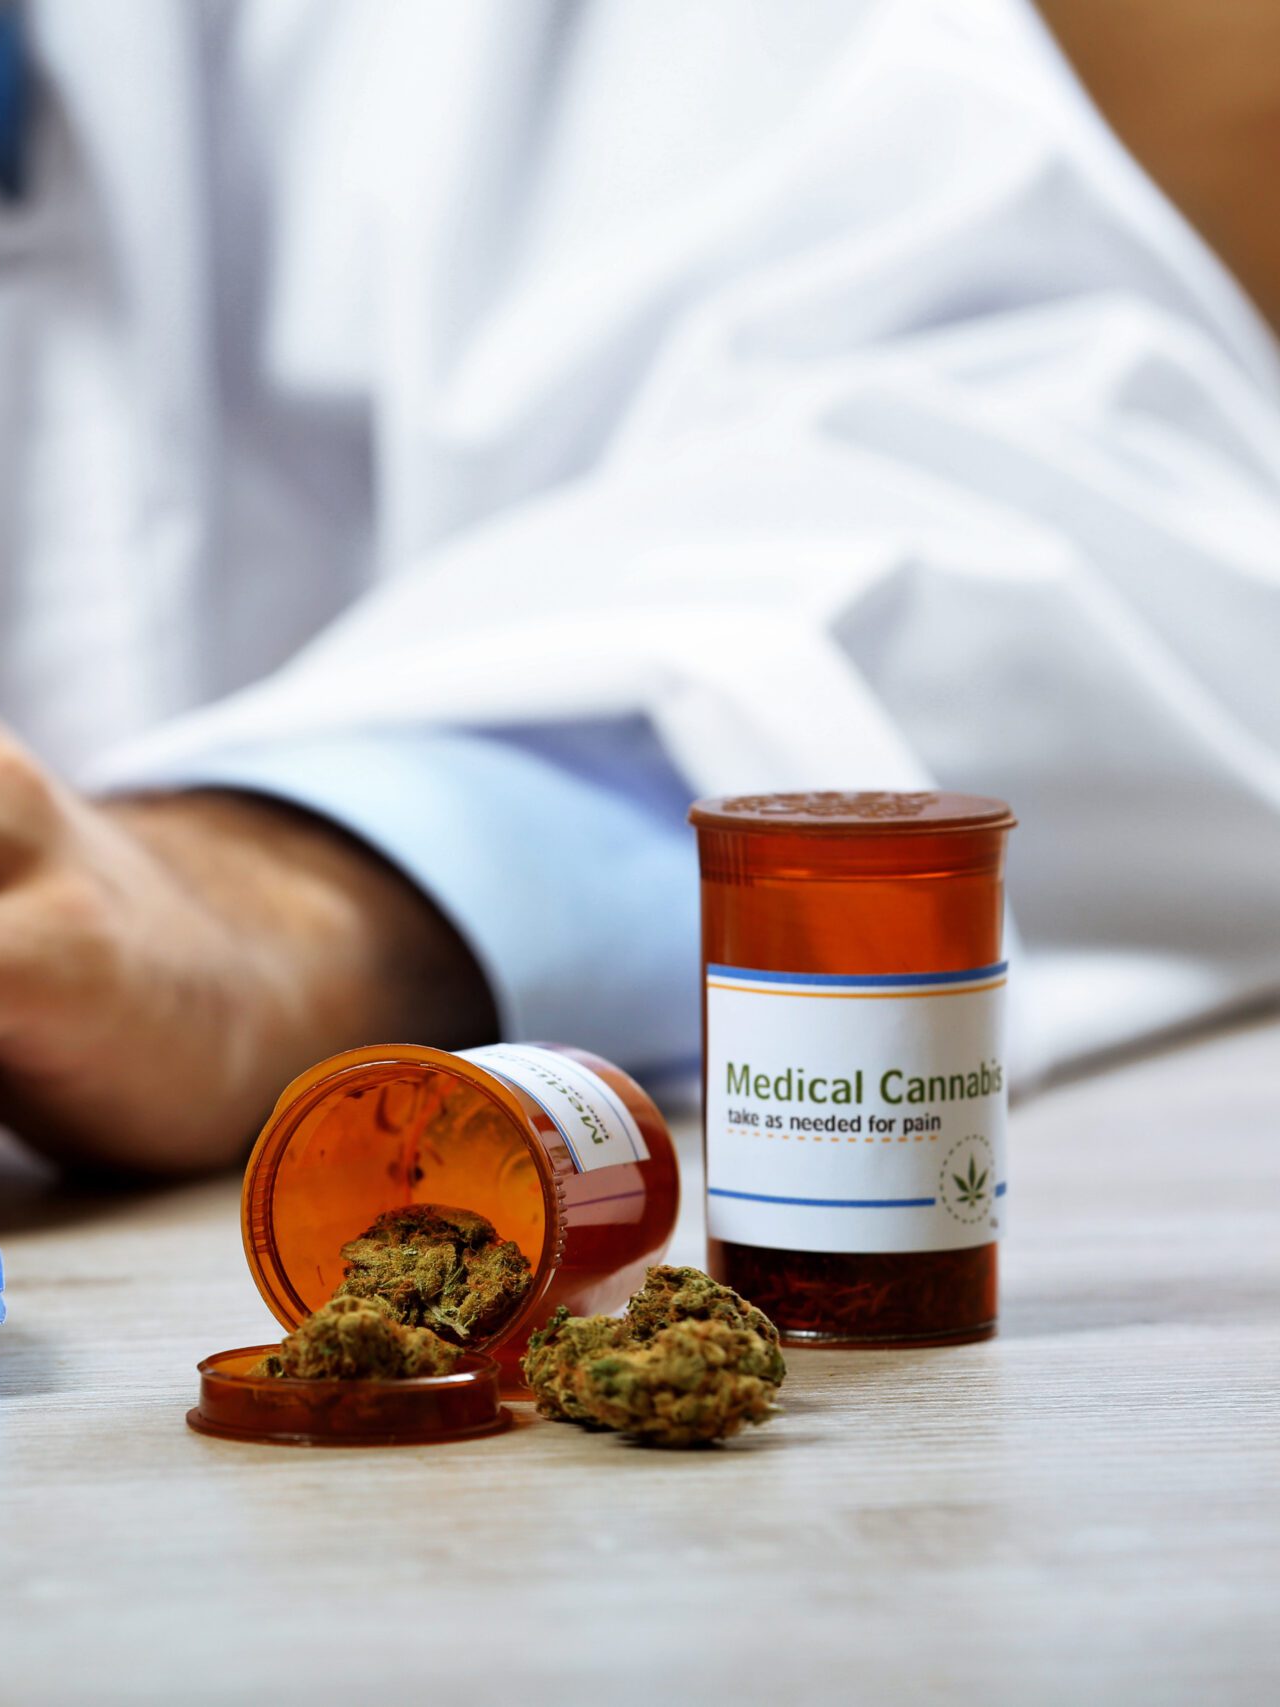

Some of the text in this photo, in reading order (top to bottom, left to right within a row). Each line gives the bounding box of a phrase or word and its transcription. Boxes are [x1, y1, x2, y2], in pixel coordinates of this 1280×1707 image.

[726, 1059, 1002, 1105] Medical Cannabis
[728, 1108, 942, 1136] take as needed for pain
